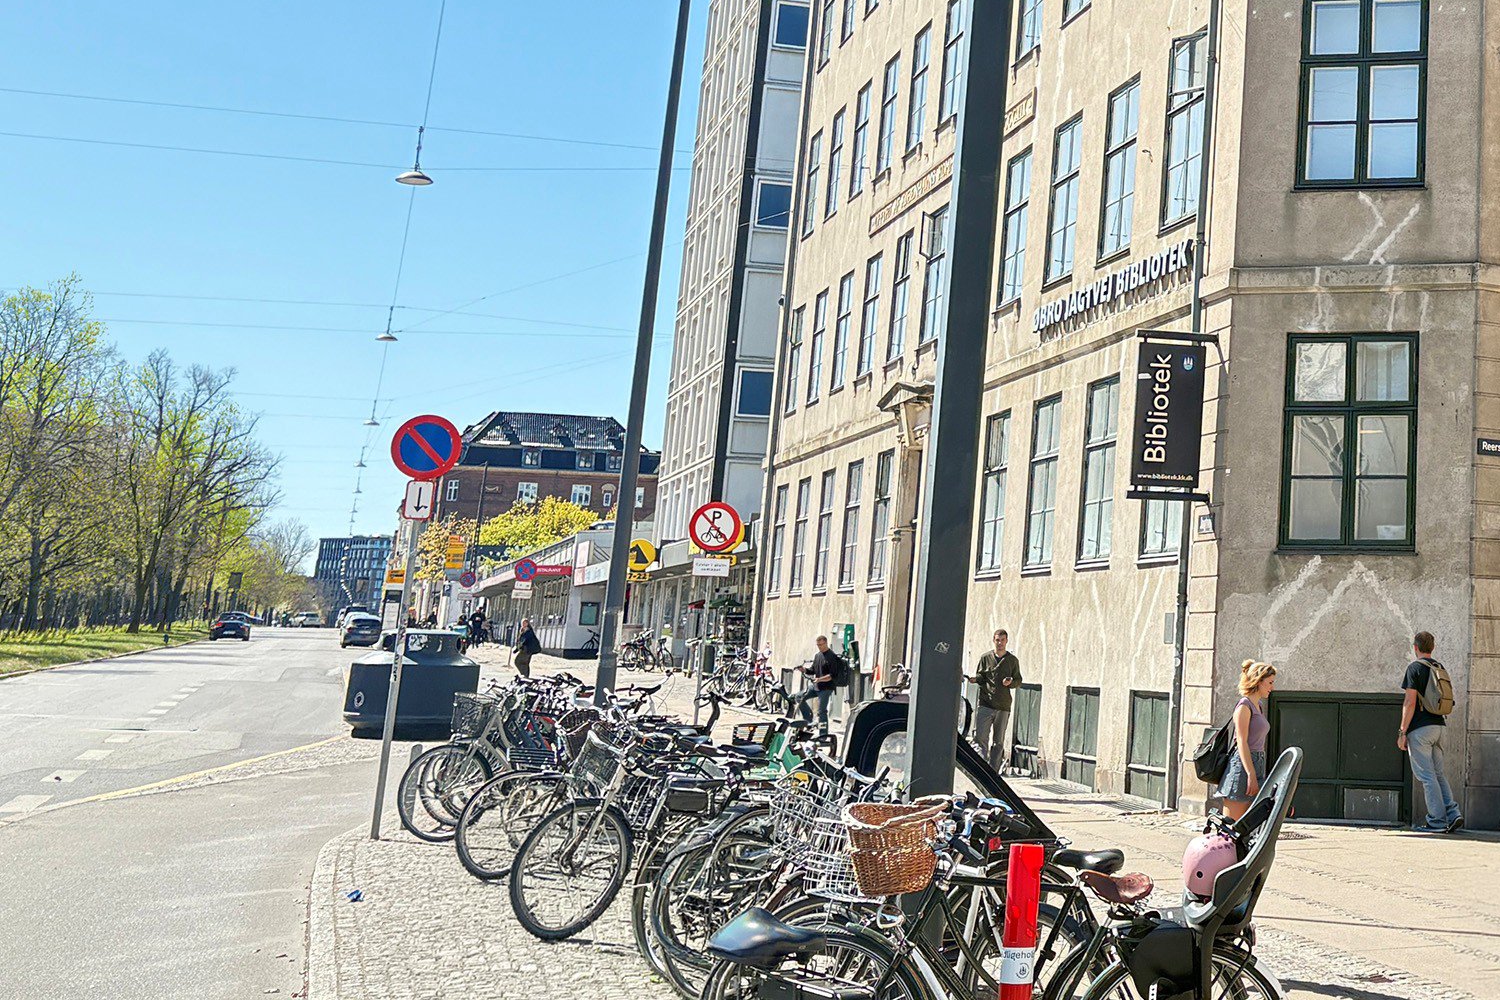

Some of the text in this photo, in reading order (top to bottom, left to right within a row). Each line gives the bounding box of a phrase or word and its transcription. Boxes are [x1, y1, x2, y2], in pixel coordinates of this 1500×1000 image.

[1064, 275, 1115, 322] JAGTVEJ
[1115, 239, 1194, 299] BIBLIOTEK
[1143, 353, 1172, 463] Bibliotek
[713, 511, 722, 524] P
